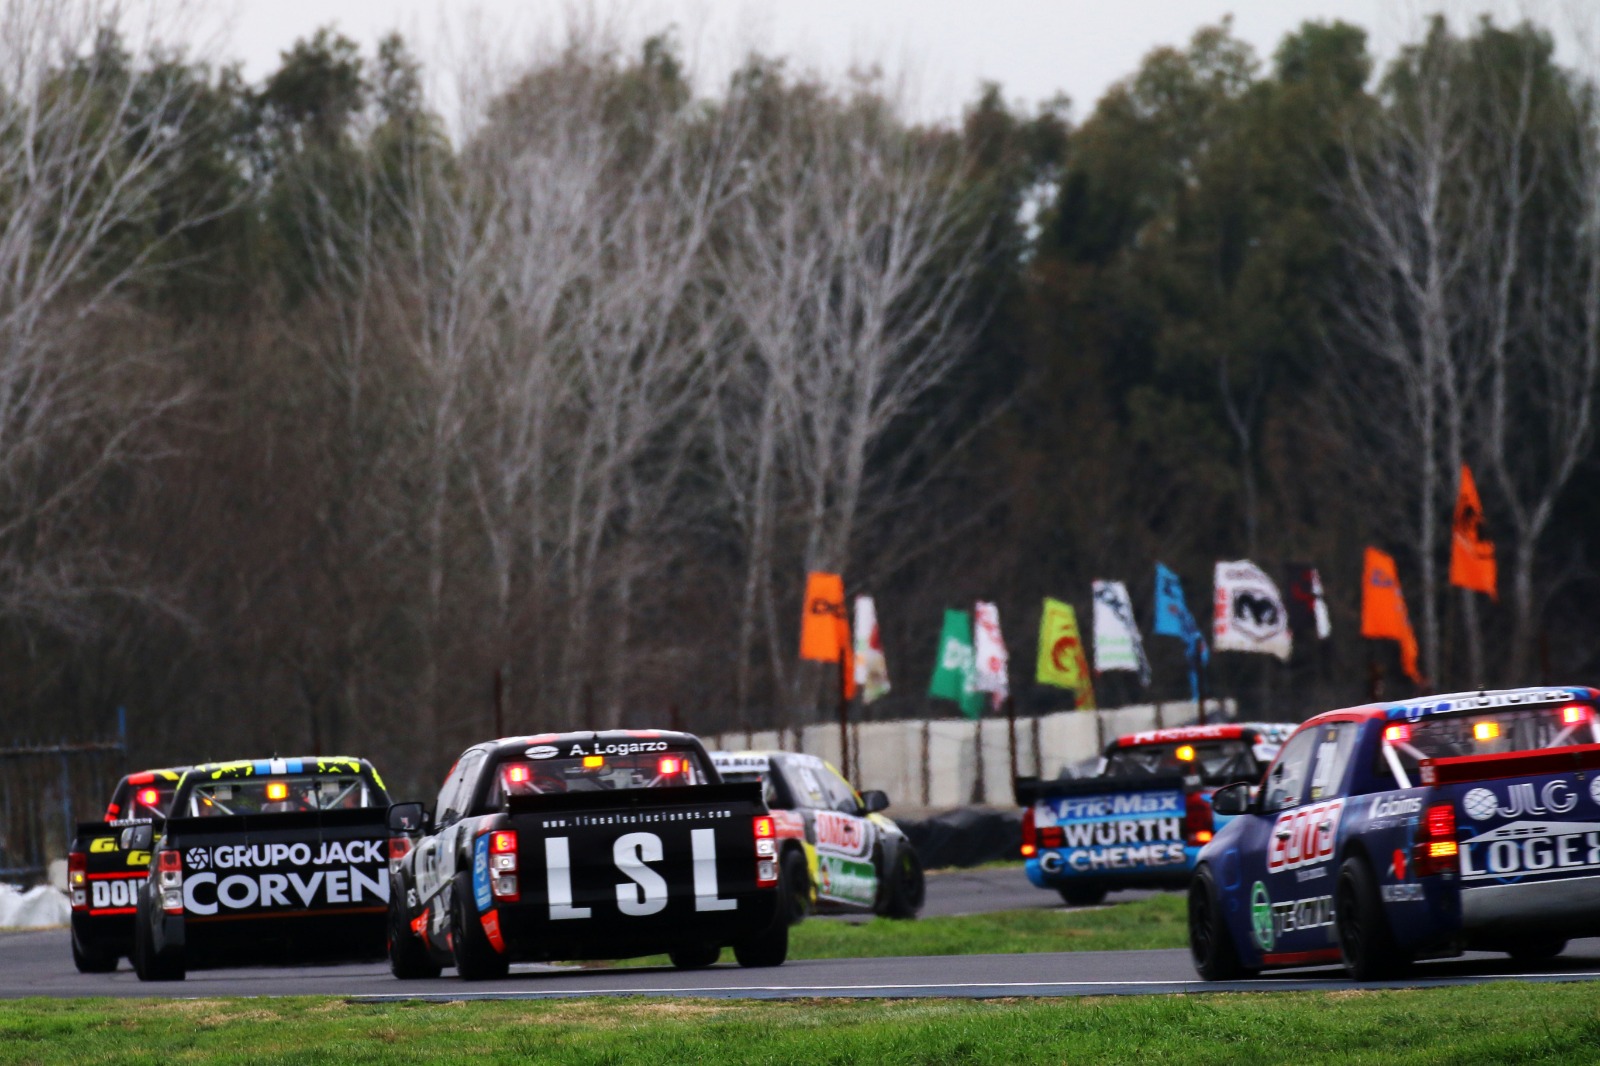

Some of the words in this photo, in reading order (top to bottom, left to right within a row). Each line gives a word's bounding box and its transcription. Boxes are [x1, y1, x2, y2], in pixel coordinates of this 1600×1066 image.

[569, 743, 589, 757] A.
[594, 741, 668, 756] Logarzo
[1496, 780, 1578, 818] JLG
[214, 842, 310, 868] GRUPO
[311, 840, 385, 864] JACK
[183, 865, 390, 915] CORVEN
